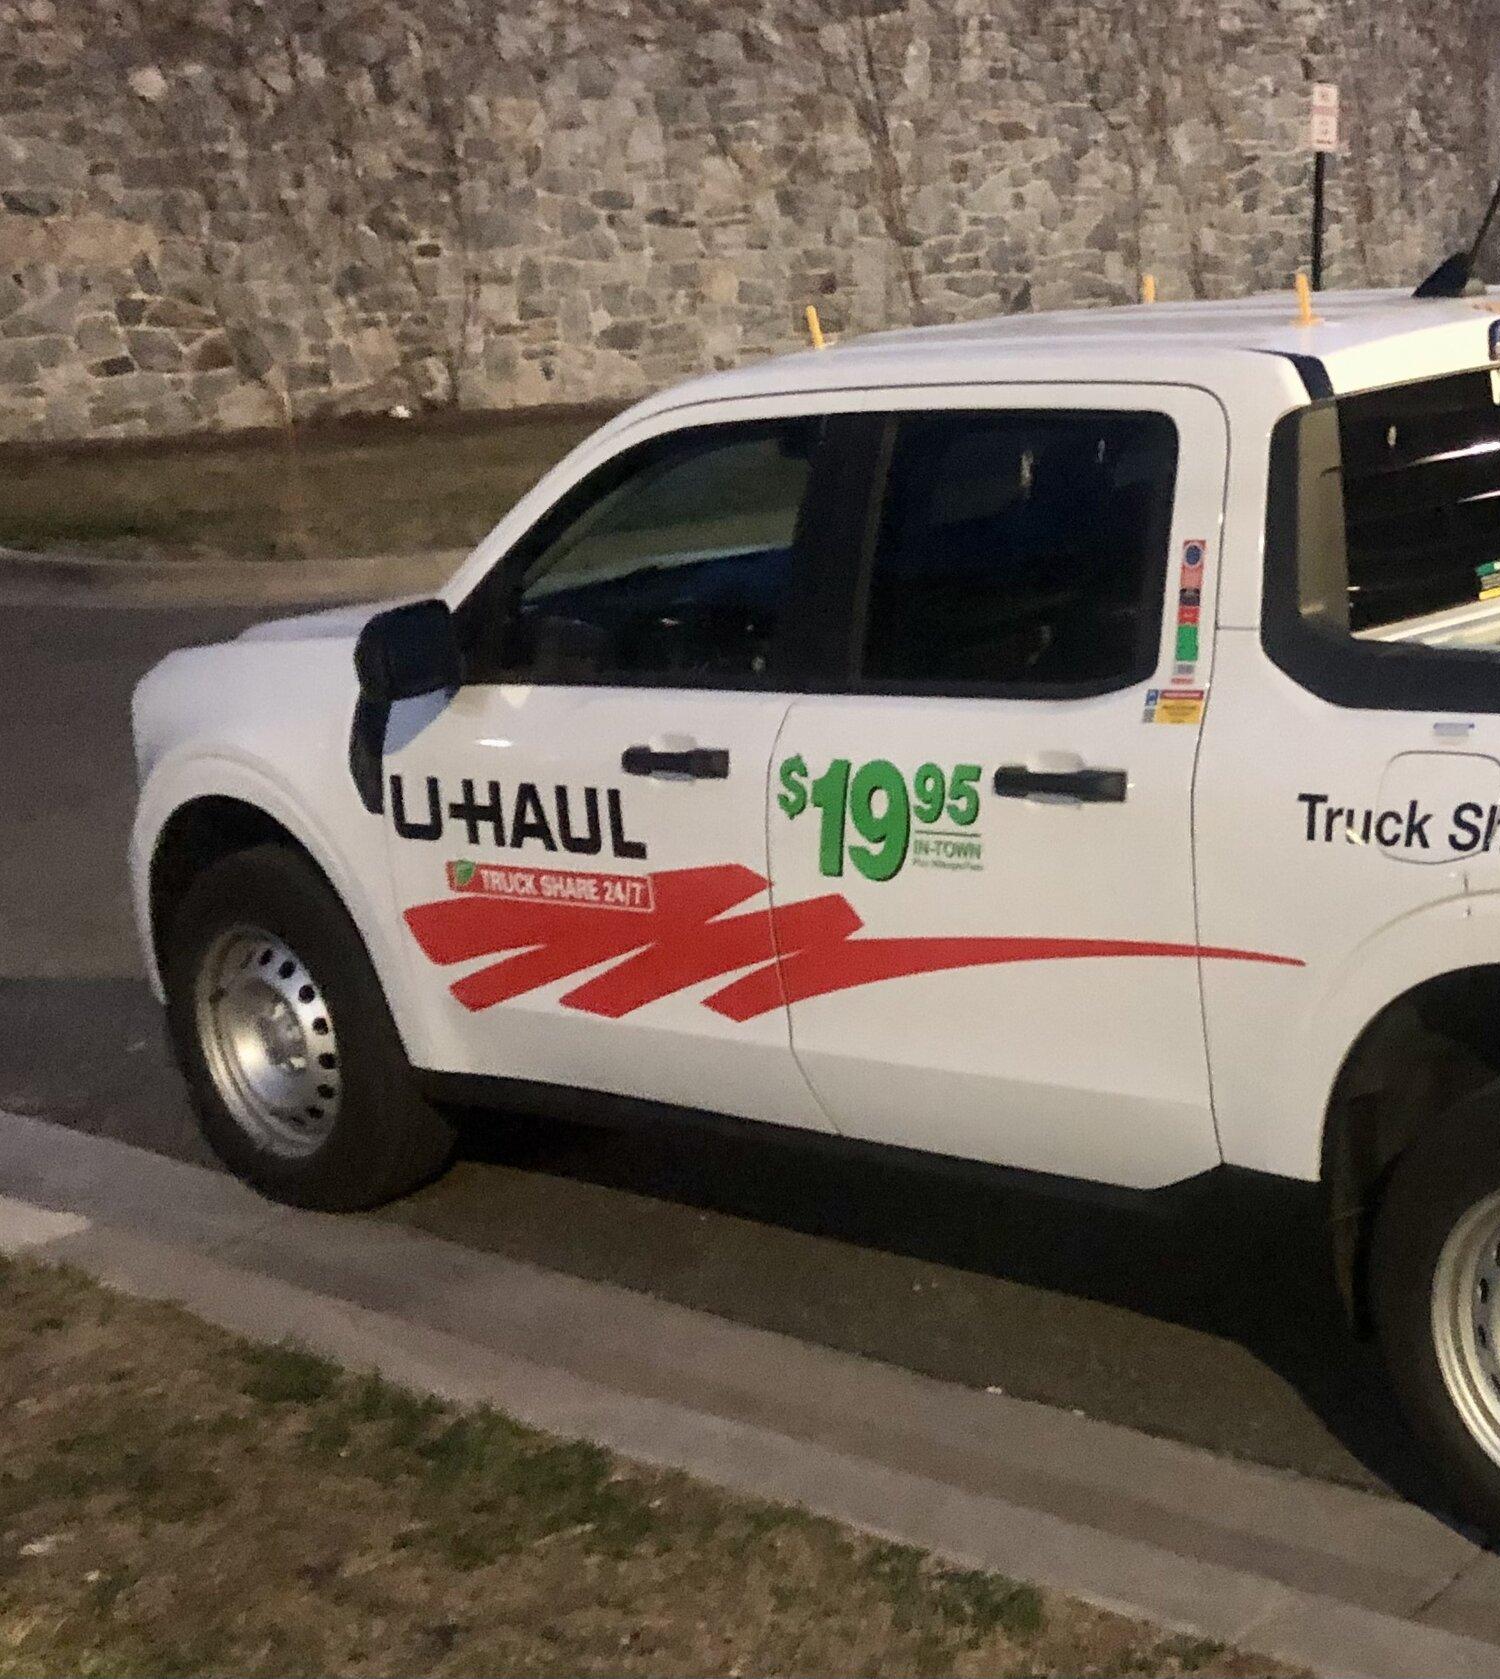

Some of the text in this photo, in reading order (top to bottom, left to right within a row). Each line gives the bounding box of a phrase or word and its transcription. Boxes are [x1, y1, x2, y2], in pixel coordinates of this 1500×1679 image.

[1297, 791, 1434, 849] Truck
[479, 867, 645, 906] TRUCK SHARE 24/7
